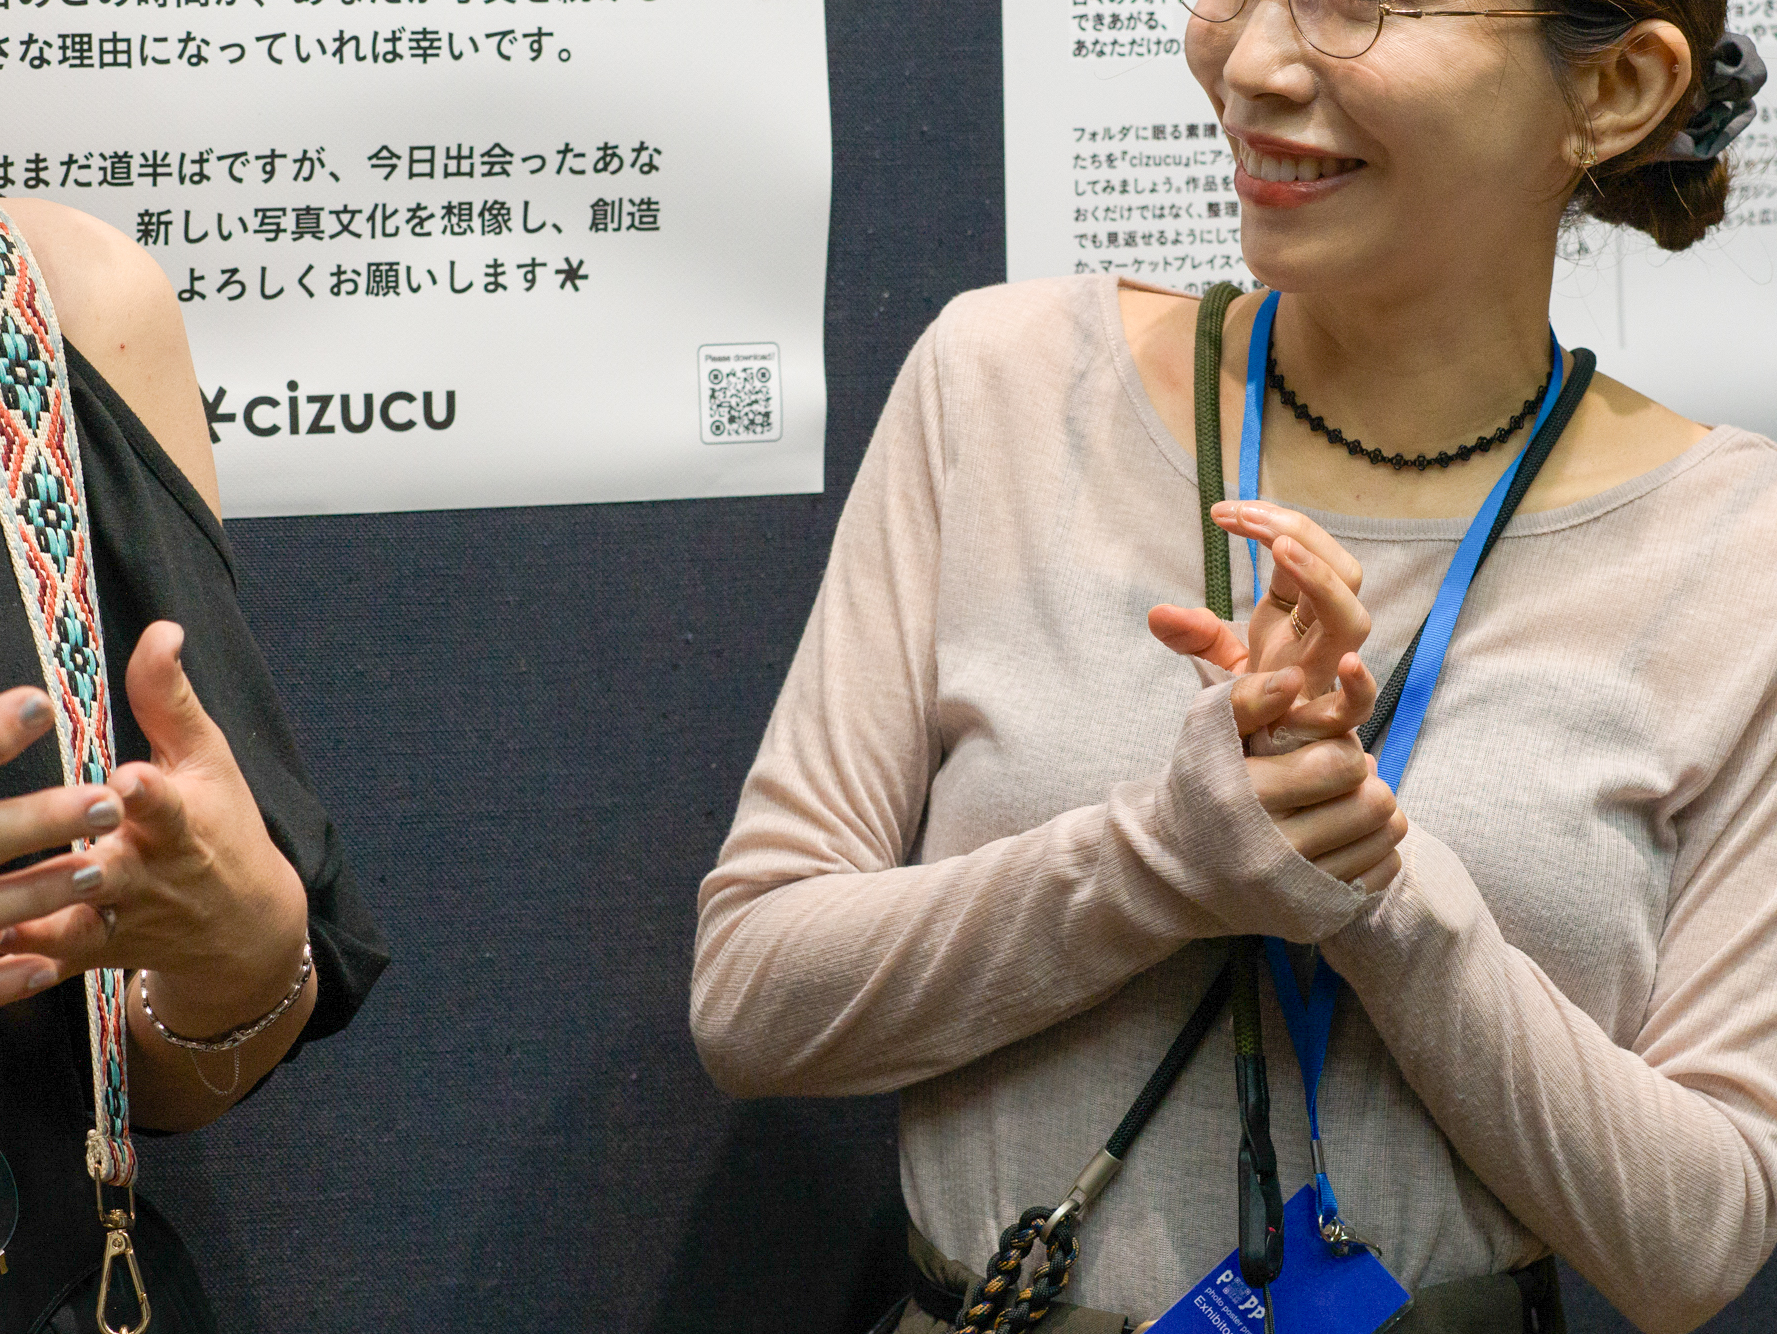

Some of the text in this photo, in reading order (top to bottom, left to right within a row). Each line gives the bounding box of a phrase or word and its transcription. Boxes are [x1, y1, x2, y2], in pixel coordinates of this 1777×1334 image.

[1072, 11, 1167, 32] できあがる、
[135, 196, 661, 247] 新しい写真文化を想像し、創造
[242, 379, 457, 438] cizucu
[1204, 1286, 1225, 1307] photo
[1221, 1305, 1243, 1329] poster
